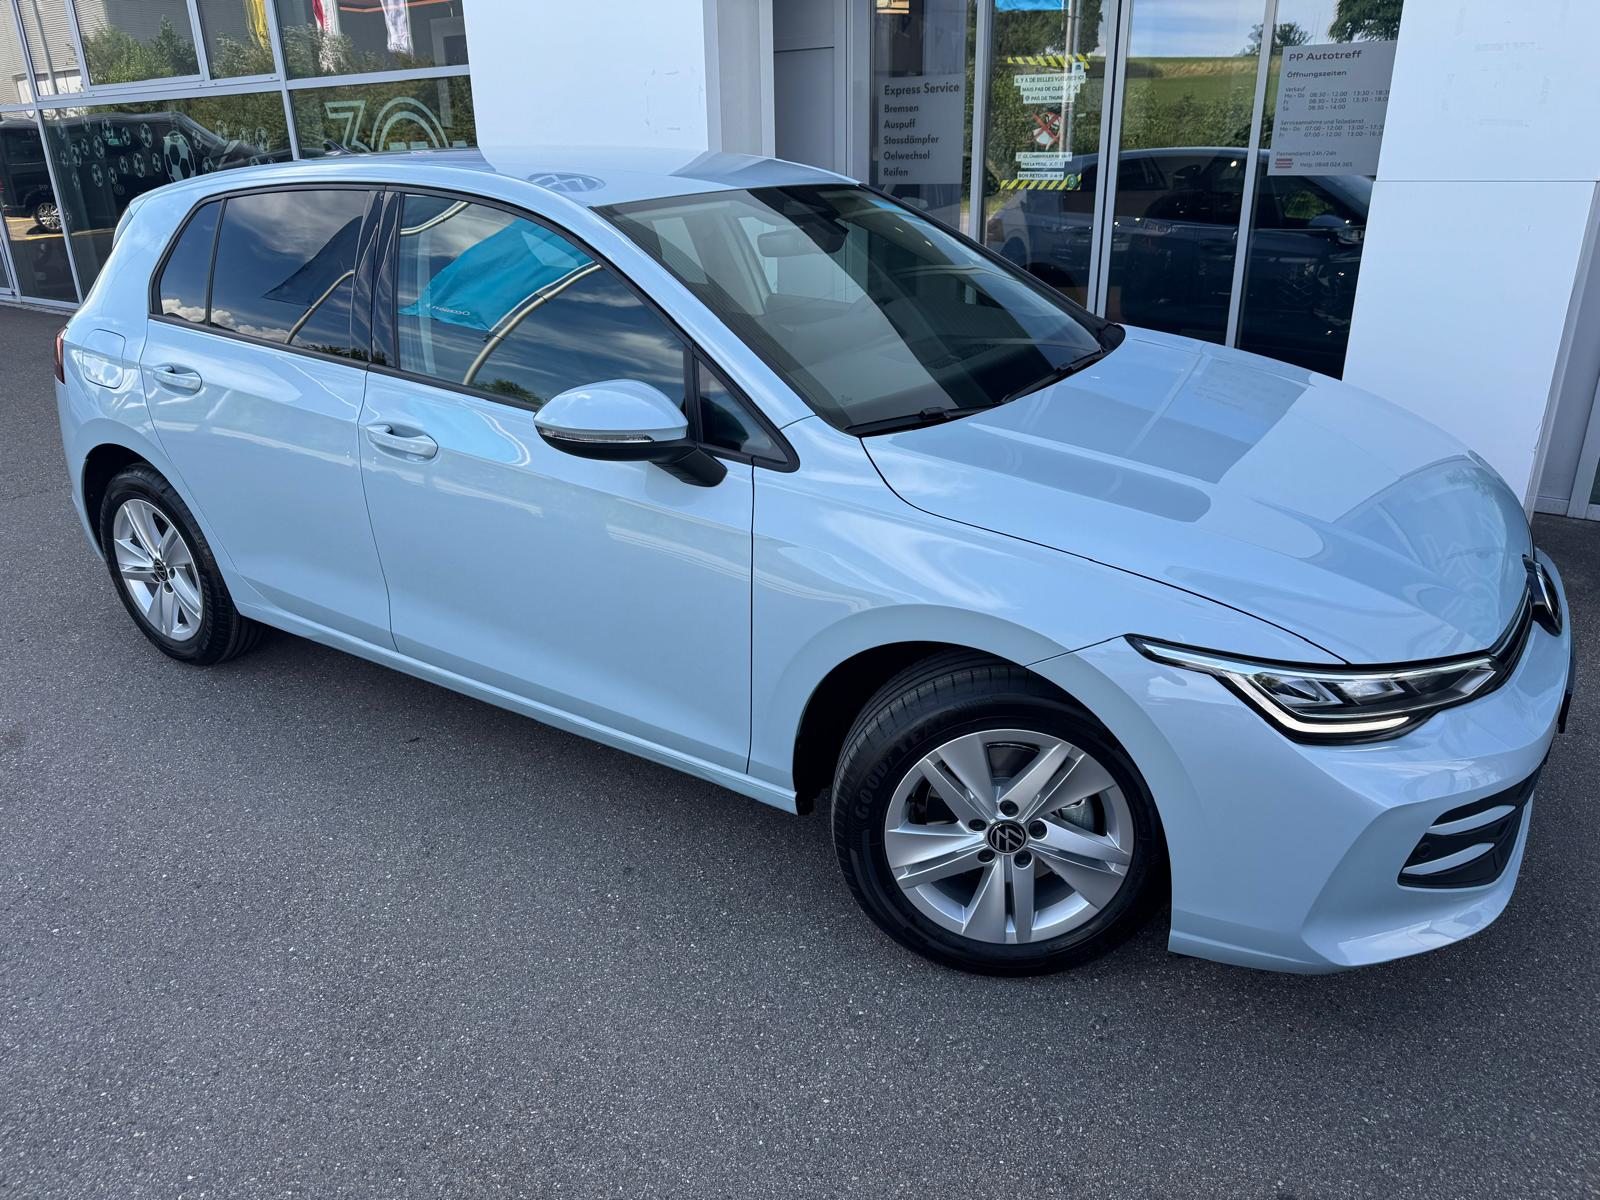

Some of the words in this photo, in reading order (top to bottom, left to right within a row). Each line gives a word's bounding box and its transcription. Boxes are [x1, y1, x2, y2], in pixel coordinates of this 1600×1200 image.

[1289, 53, 1303, 61] PP
[1306, 50, 1362, 61] Autotreff
[1287, 70, 1347, 79] Öffnungszeiten
[884, 85, 920, 98] Express
[923, 82, 960, 94] Service
[884, 104, 919, 113] Bremsen
[884, 119, 916, 130] Auspuff
[883, 134, 939, 146] Stossdämpfer
[883, 151, 930, 160] Oelwechsel
[883, 167, 909, 177] Reifen
